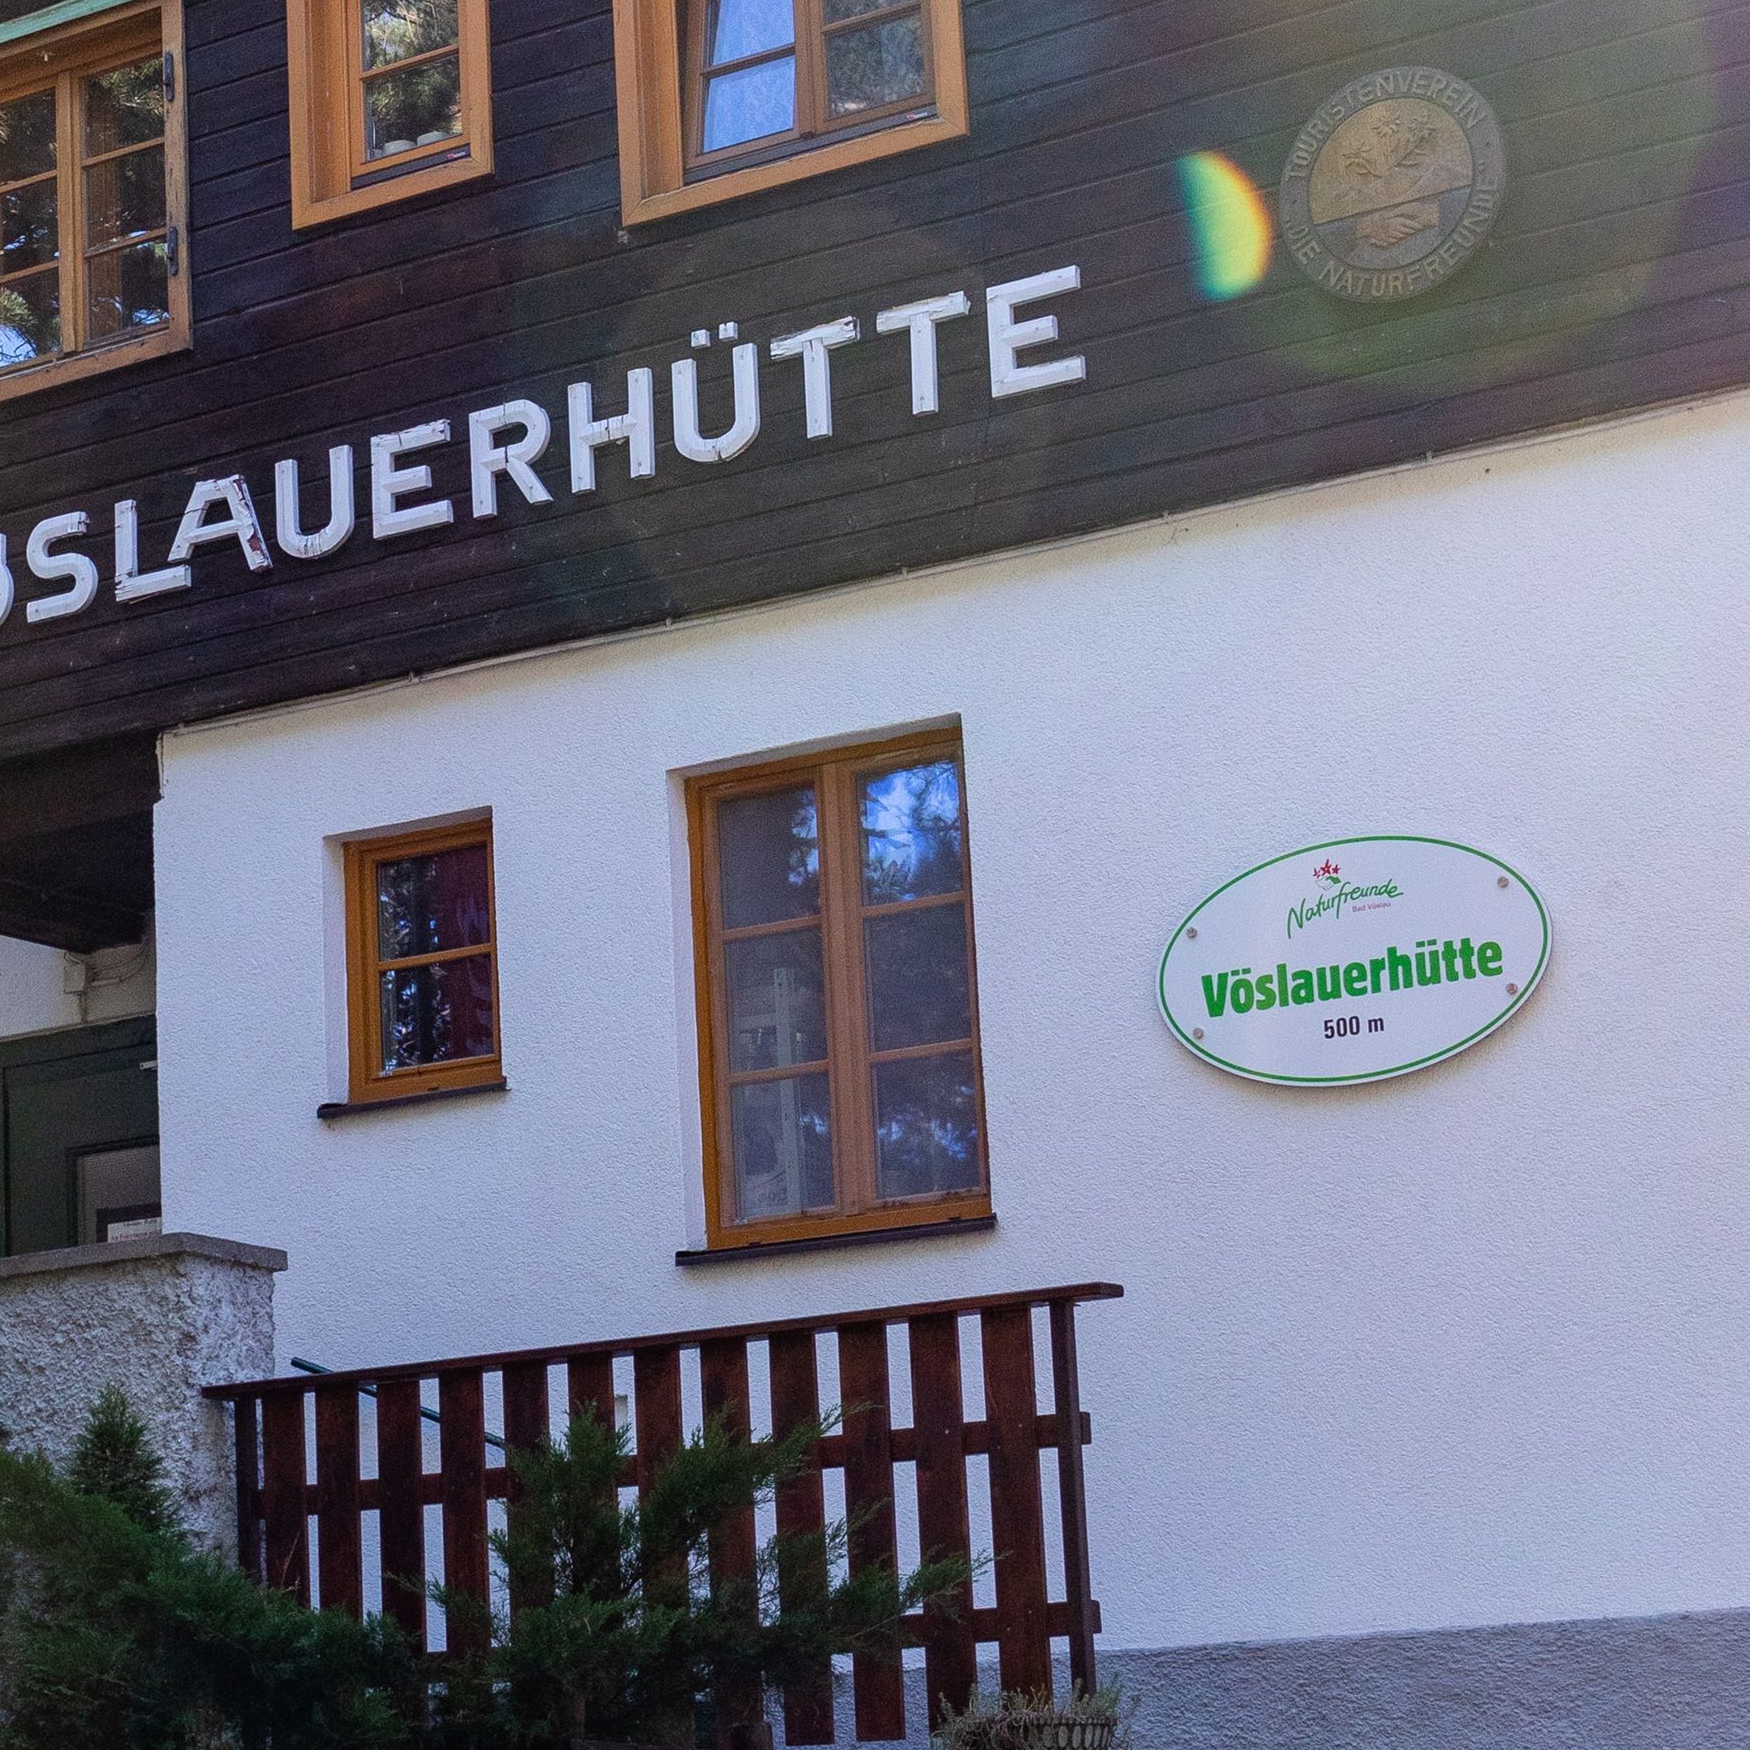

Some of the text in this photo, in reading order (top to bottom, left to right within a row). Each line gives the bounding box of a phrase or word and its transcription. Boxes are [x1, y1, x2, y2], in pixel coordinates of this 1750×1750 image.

[1284, 69, 1490, 183] TOURISTENVEREIN
[1287, 878, 1404, 939] Naturfreunde
[1352, 902, 1392, 913] Bad Vöslau
[1201, 937, 1503, 1018] Vöslauerhütte
[1323, 1015, 1385, 1039] 500 m
